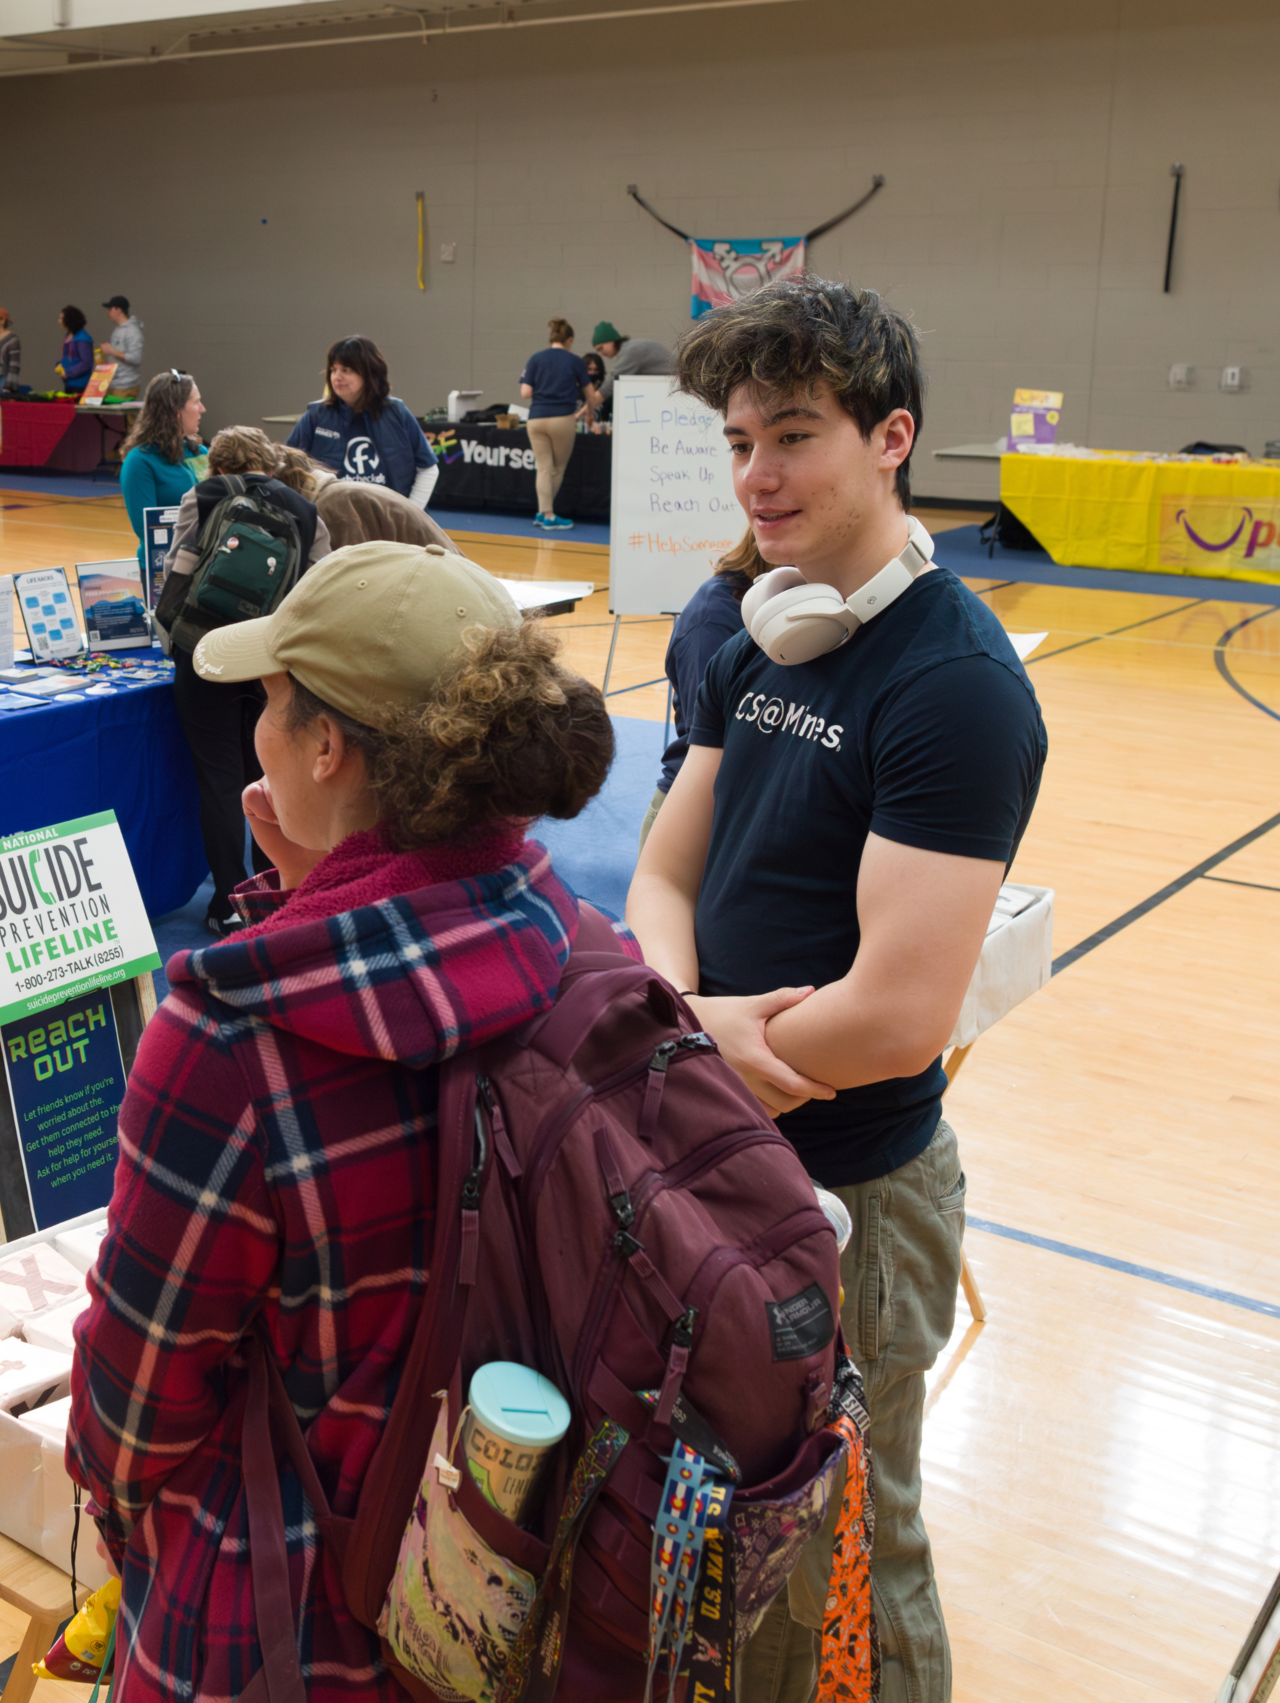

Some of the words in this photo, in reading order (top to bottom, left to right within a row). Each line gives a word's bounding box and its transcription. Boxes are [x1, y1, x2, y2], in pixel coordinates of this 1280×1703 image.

[625, 395, 651, 424] I
[460, 439, 538, 470] Yourse
[650, 436, 669, 455] Be
[675, 440, 718, 457] Aware
[650, 466, 690, 487] Speak
[699, 467, 714, 485] Up
[650, 492, 700, 512] Reach
[709, 497, 738, 512] Out
[2, 828, 59, 850] NATIONAL
[5, 918, 118, 974] LIFELINE
[15, 956, 94, 993] 1-800-273-TALK
[95, 945, 124, 969] (8255)
[26, 968, 126, 1010] suicidepreventionlifeline.org
[34, 1038, 90, 1082] OUT
[24, 1112, 37, 1122] Let
[37, 1098, 64, 1116] friends
[64, 1091, 84, 1104] know
[84, 1085, 91, 1095] if
[91, 1077, 114, 1094] you're
[38, 1113, 66, 1131] worried
[67, 1104, 89, 1118] about
[90, 1097, 104, 1109] the.
[26, 1140, 40, 1152] Get
[41, 1131, 60, 1146] them
[61, 1112, 100, 1136] connected
[100, 1110, 110, 1119] to
[48, 1144, 65, 1158] help
[66, 1135, 82, 1150] they
[84, 1126, 104, 1142] need.
[38, 1166, 51, 1180] Ask
[51, 1161, 62, 1172] for
[63, 1153, 80, 1167] help
[80, 1147, 91, 1158] for
[51, 1174, 71, 1188] when
[72, 1166, 86, 1181] you
[87, 1157, 106, 1171] need
[106, 1152, 114, 1162] it.
